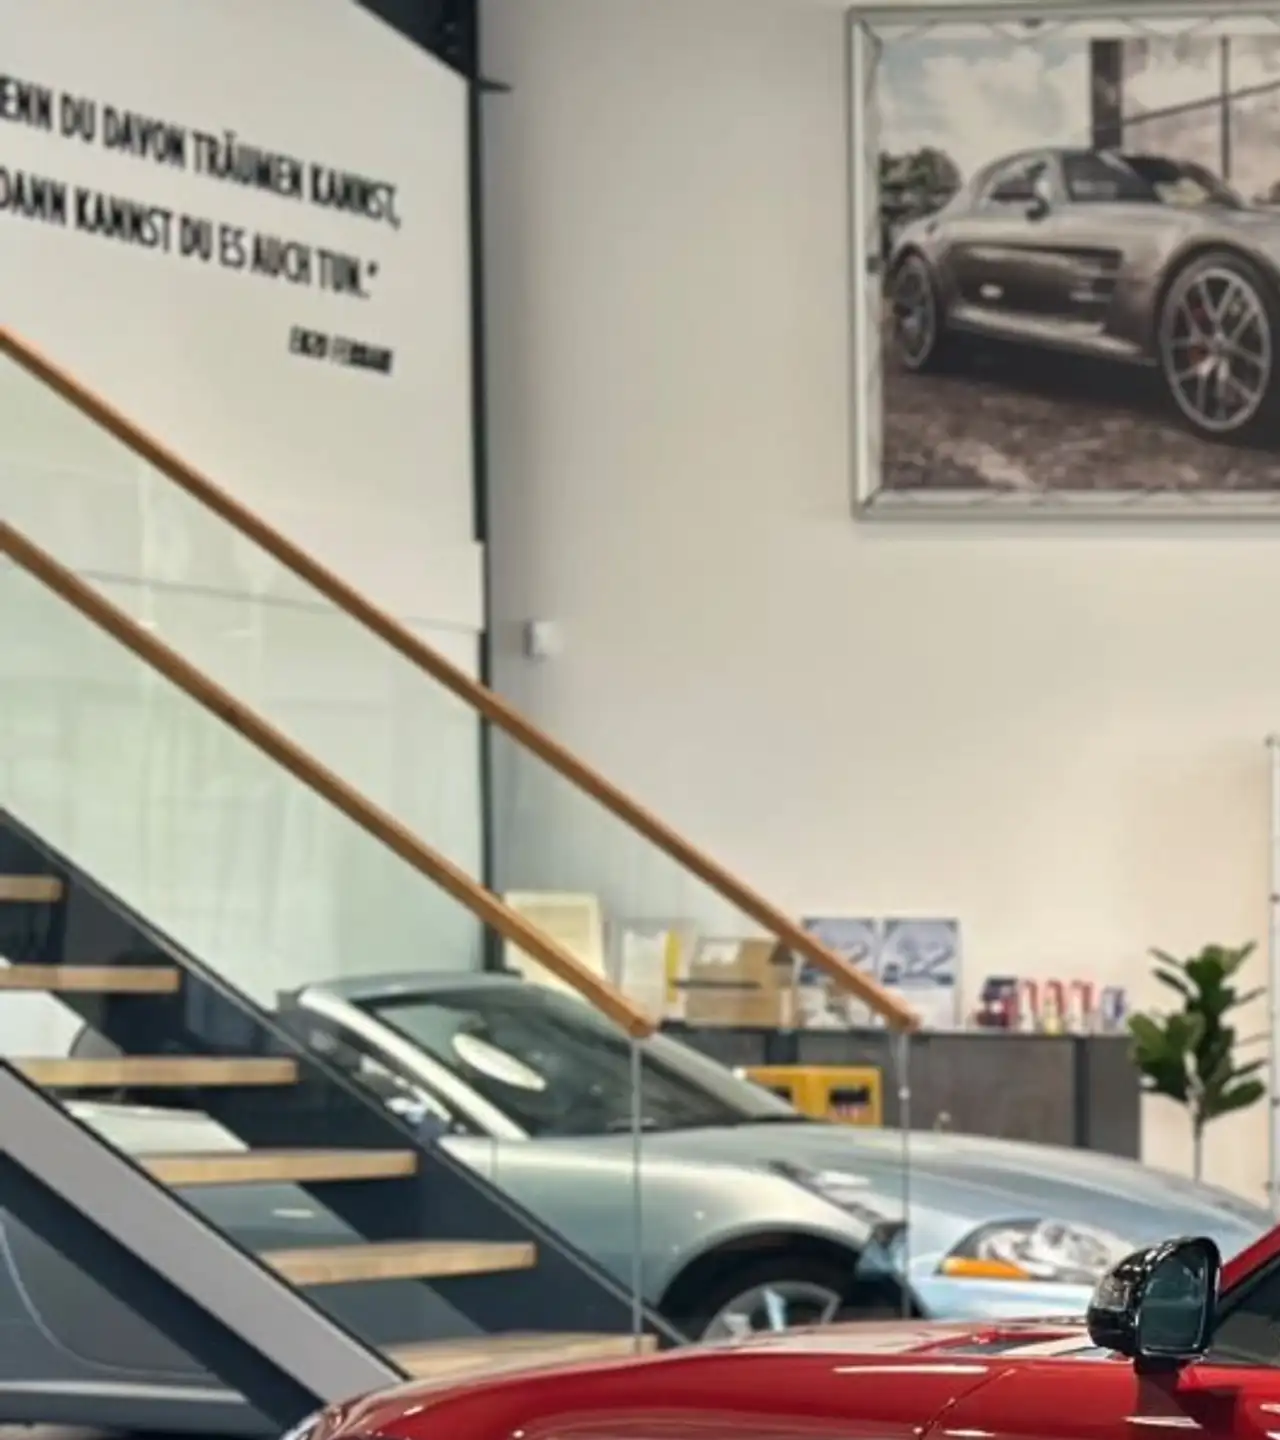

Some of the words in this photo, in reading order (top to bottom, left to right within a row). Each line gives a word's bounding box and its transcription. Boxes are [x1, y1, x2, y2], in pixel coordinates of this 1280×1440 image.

[60, 90, 96, 143] DU
[104, 104, 186, 169] DAVON
[193, 128, 303, 200] TRÄUMEN
[75, 185, 173, 254] KANNST
[179, 212, 213, 262] DU
[219, 221, 247, 269] ES
[252, 231, 312, 287] AUCH
